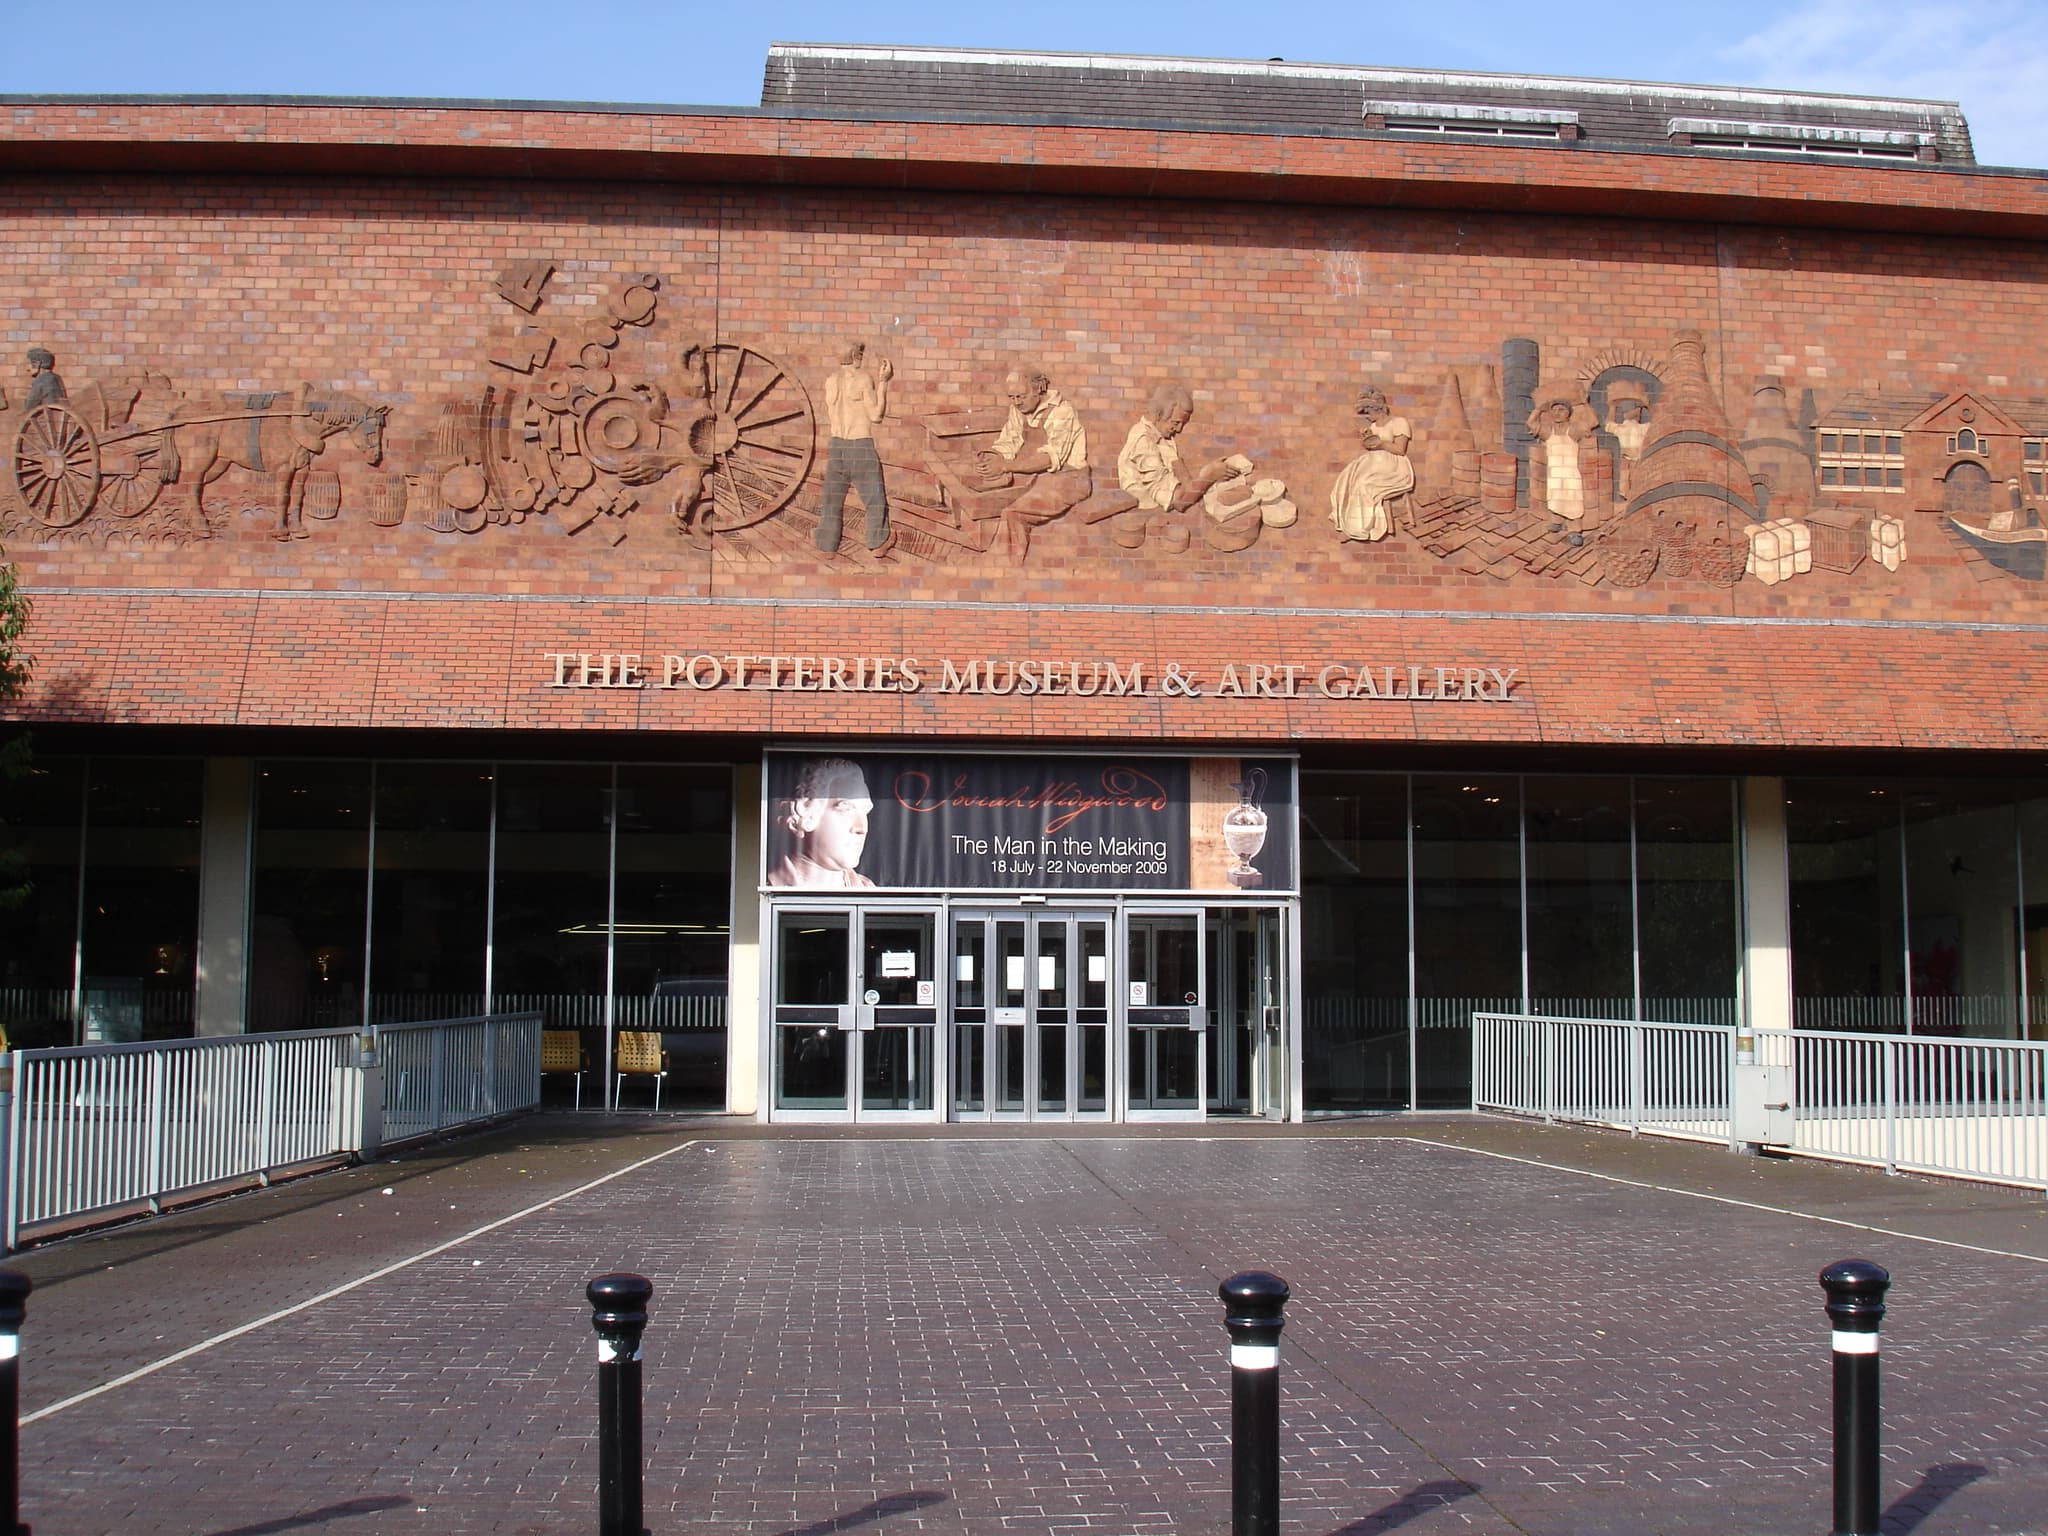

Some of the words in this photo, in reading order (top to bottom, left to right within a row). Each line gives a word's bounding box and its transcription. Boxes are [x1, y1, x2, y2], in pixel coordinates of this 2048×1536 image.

[544, 652, 644, 689] THE
[661, 654, 921, 692] POTTERIES
[939, 658, 1145, 696] MUSEUM
[1161, 662, 1201, 697] &
[1219, 663, 1305, 698] ART
[1318, 665, 1518, 701] GALLERY
[952, 835, 988, 854] The
[994, 836, 1035, 855] Man
[1041, 836, 1057, 855] in
[1063, 837, 1093, 855] the
[1099, 837, 1167, 860] Making
[991, 860, 1006, 873] 18
[1010, 860, 1035, 876] July
[1047, 861, 1063, 873] 22
[1067, 861, 1132, 873] November
[1135, 862, 1167, 874] 2009
